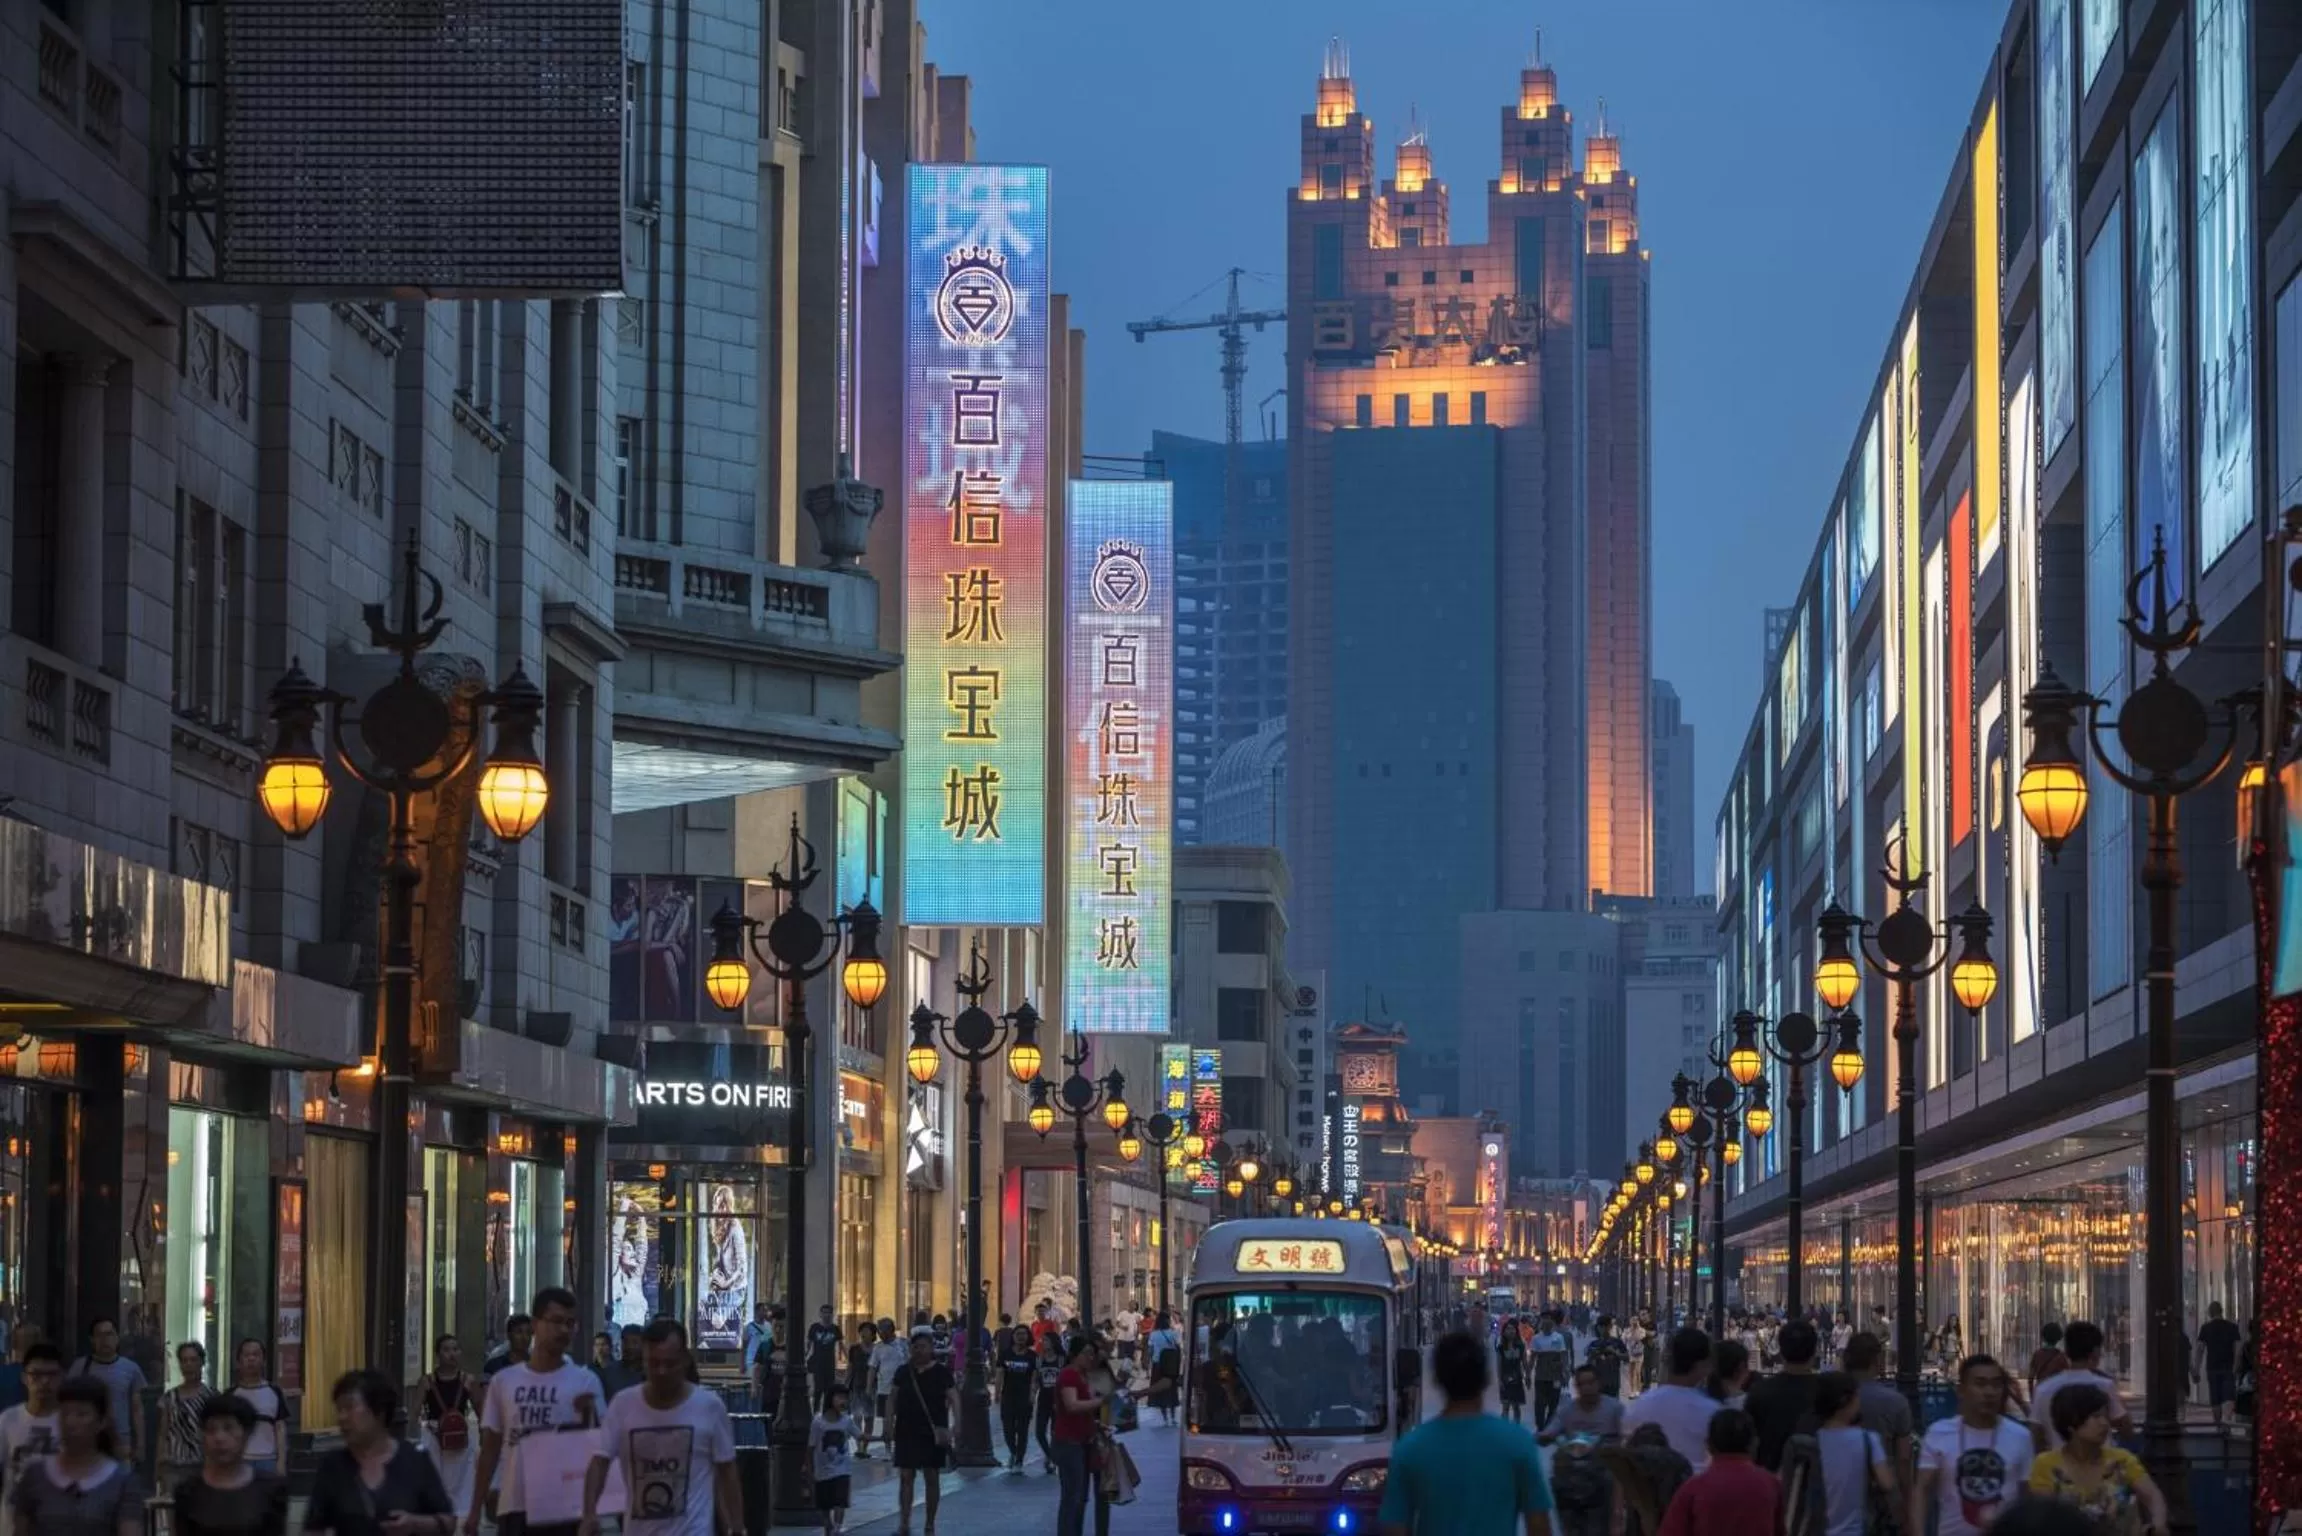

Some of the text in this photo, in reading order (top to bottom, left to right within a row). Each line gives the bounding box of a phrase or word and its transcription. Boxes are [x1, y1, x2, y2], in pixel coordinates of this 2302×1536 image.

[945, 373, 1003, 839] 百信珠宝城
[1097, 634, 1139, 969] 百信珠宝城
[711, 1083, 750, 1106] ON
[514, 1385, 558, 1404] CALL
[519, 1405, 552, 1424] THE
